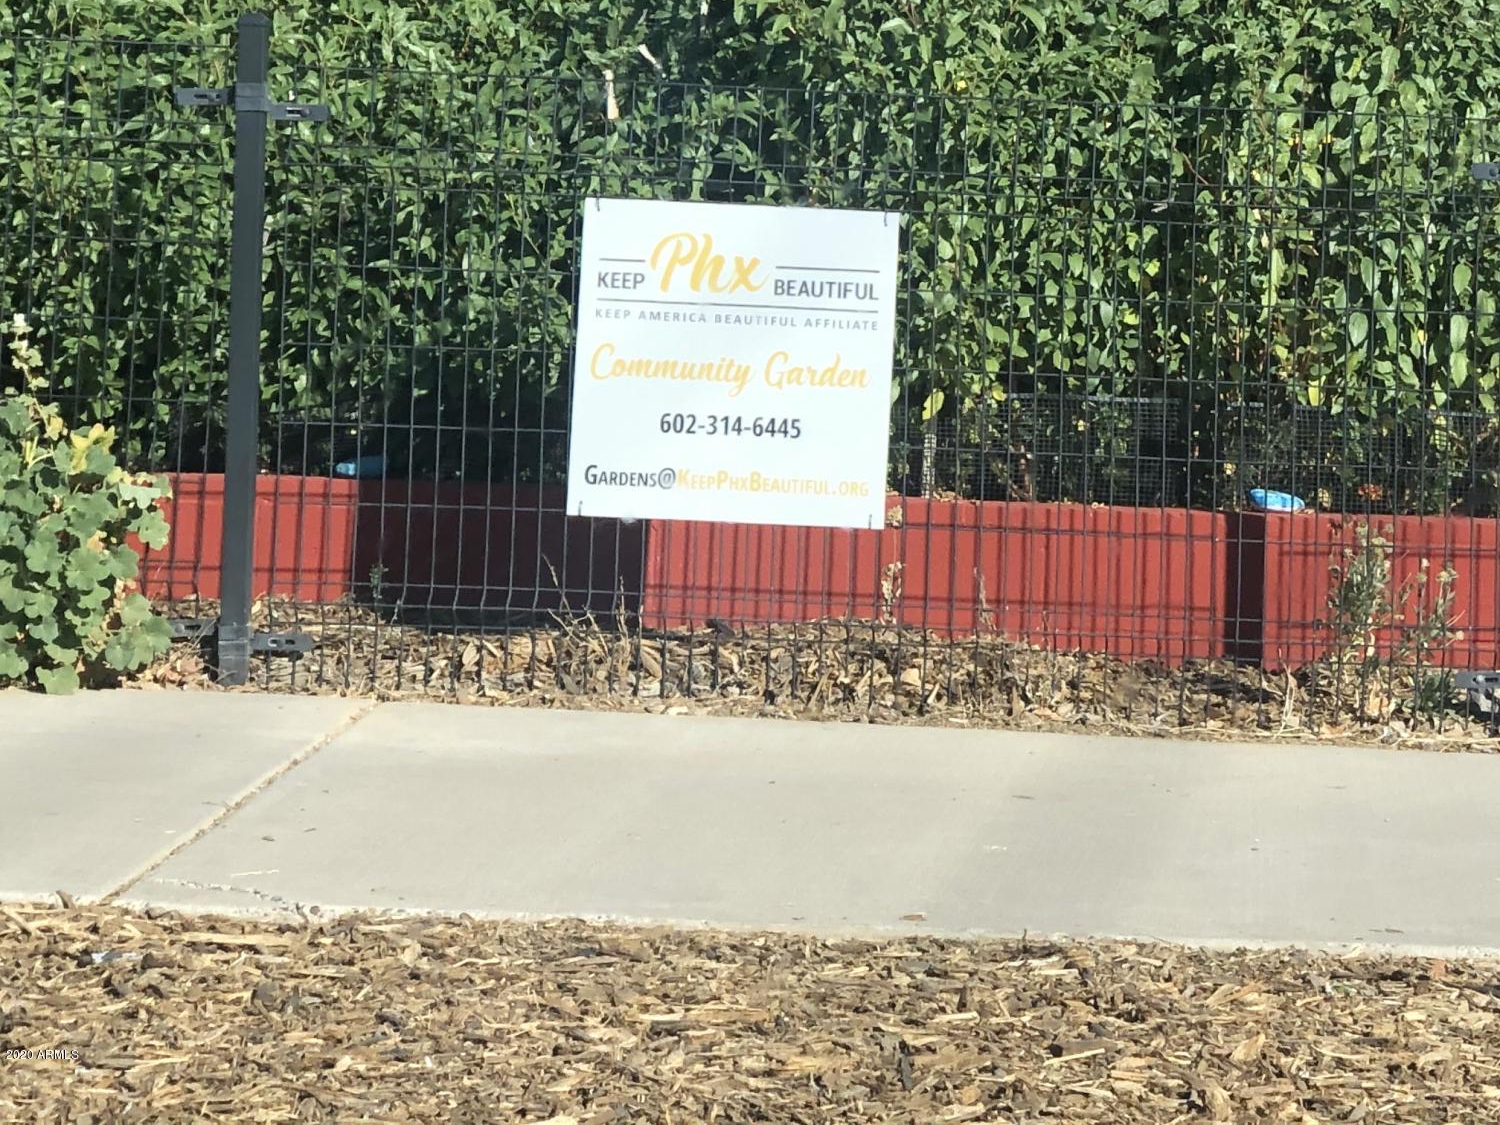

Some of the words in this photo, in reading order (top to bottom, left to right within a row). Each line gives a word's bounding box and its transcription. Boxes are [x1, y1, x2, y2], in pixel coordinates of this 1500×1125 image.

[596, 271, 646, 291] KEEP
[649, 232, 769, 294] Phx
[772, 278, 880, 301] BEAUTIFUL
[595, 307, 631, 320] KEEP
[637, 310, 708, 324] AMERICA
[713, 313, 798, 328] BEAUTIFUL
[803, 317, 879, 331] AFFILIATE
[589, 342, 754, 398] Community
[763, 350, 870, 390] Garden
[659, 412, 803, 440] 602-314-6445
